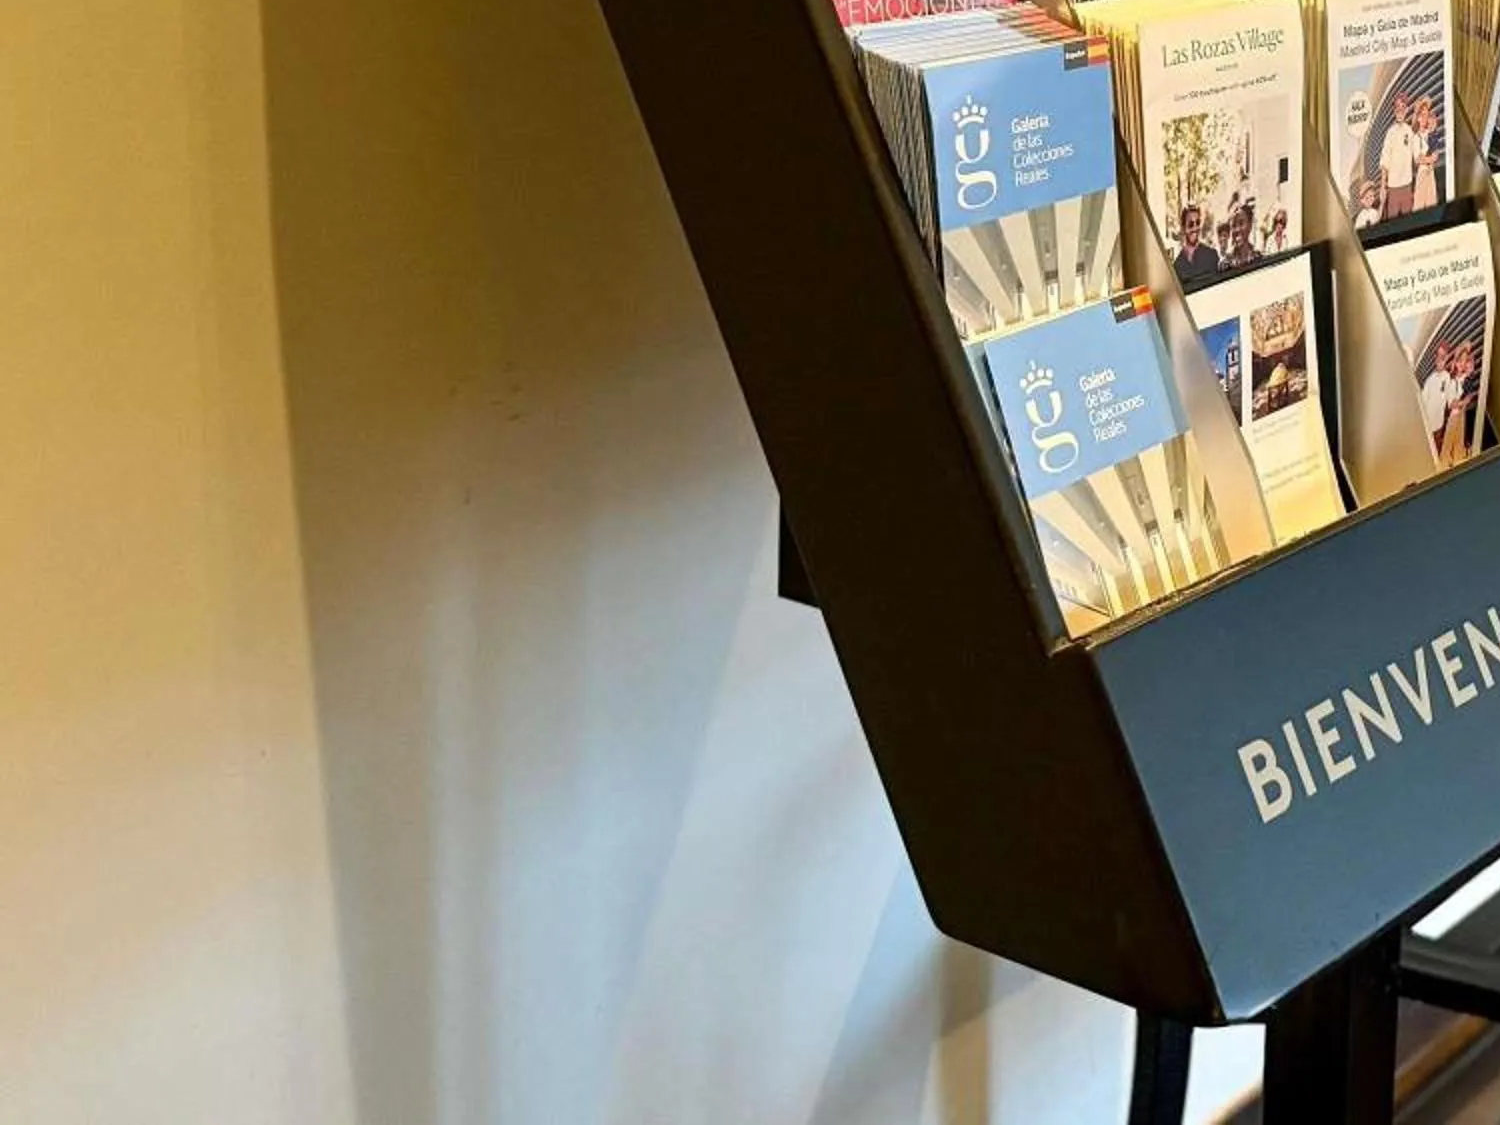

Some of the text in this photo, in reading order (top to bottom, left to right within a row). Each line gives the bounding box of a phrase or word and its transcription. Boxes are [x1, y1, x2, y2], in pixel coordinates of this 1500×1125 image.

[1343, 19, 1369, 39] Mapa
[1410, 10, 1439, 27] Madrid
[1162, 27, 1285, 69] Las Rozas Village
[1012, 134, 1043, 151] de las
[1013, 144, 1074, 168] Colecciones
[1016, 168, 1050, 187] Reales
[1384, 274, 1409, 292] Mapa
[1449, 255, 1480, 275] Madrid
[1089, 394, 1145, 426] Colecciones
[1093, 419, 1128, 443] Reales
